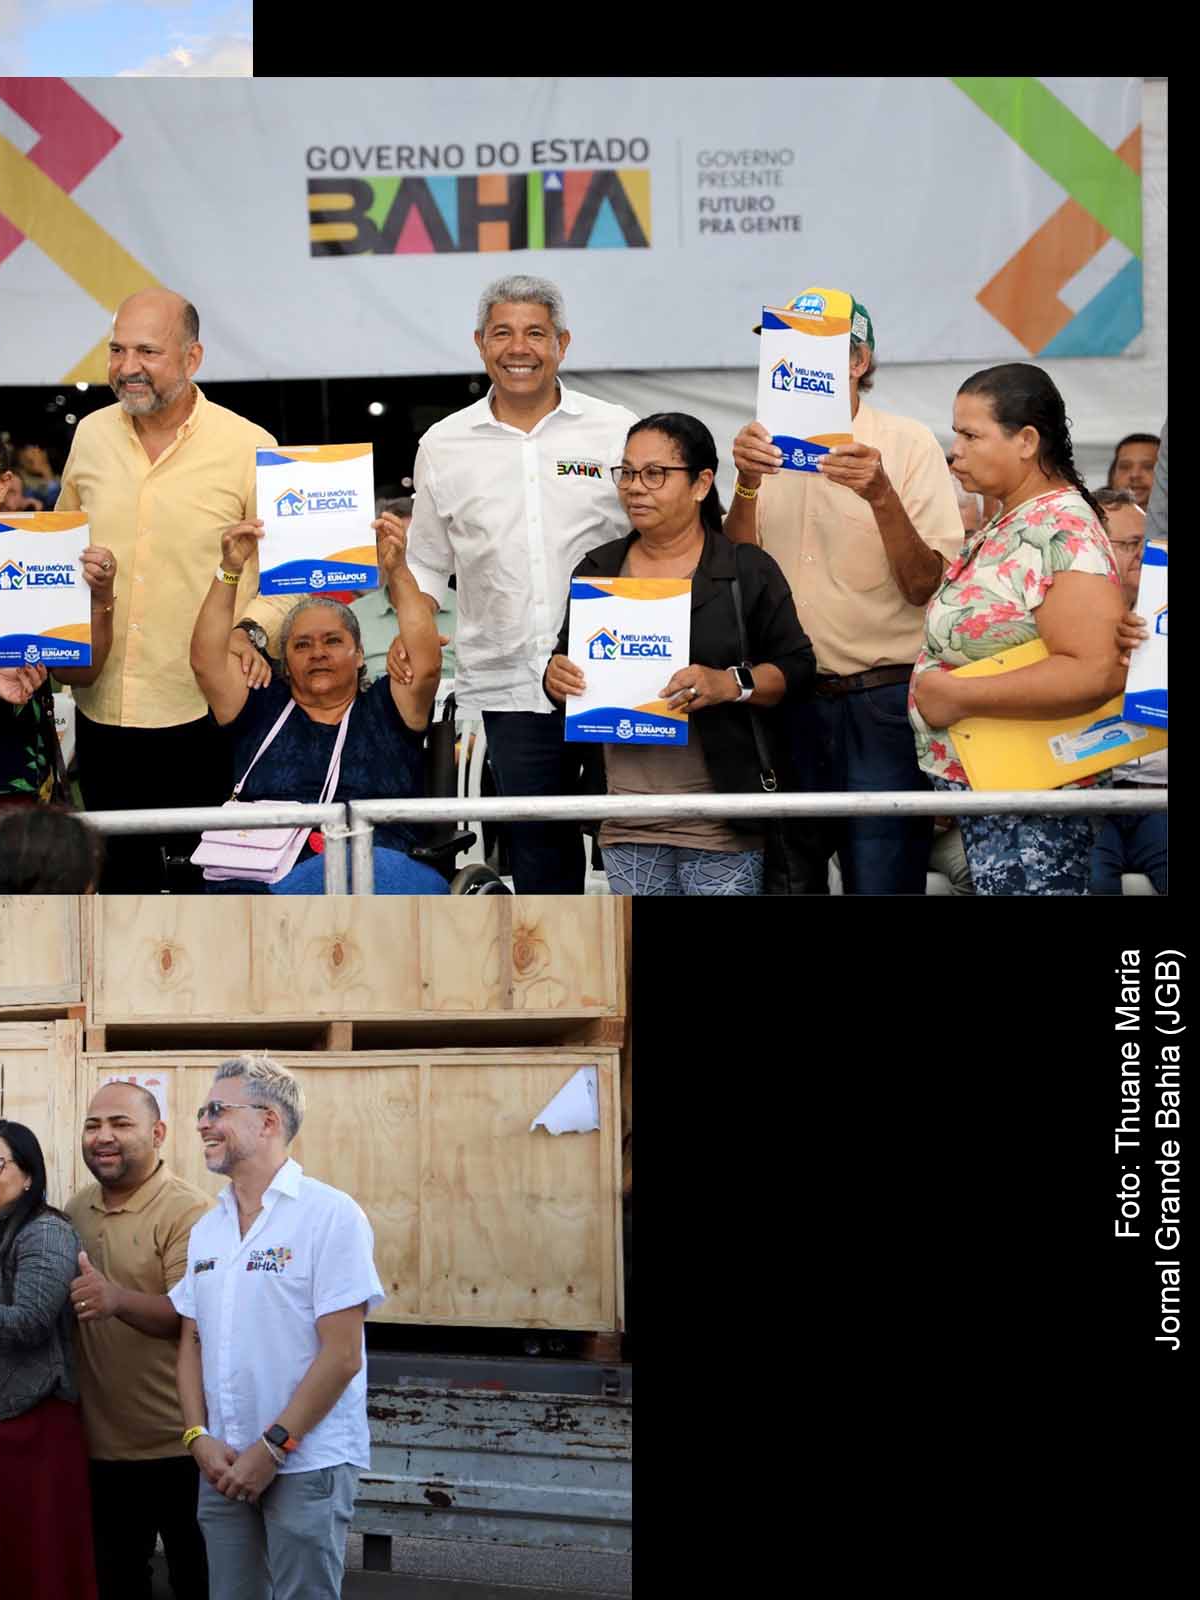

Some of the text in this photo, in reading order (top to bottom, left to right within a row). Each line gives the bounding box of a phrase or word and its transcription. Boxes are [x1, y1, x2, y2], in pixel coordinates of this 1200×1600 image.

[306, 137, 650, 171] GOVERNO DO ESTADO
[697, 148, 795, 169] GOVERNO
[698, 169, 784, 189] PRESENTE
[699, 195, 775, 213] FUTURO
[308, 169, 652, 258] BAHIA
[699, 214, 802, 235] PRA GENTE
[794, 376, 835, 394] LEGAL
[327, 489, 358, 498] IMÓVEL
[308, 498, 358, 511] LEGAL
[45, 563, 76, 572] IMÓVEL
[26, 573, 75, 585] LEGAL
[621, 633, 672, 643] MEU IMÓVEL
[620, 643, 672, 657] LEGAL
